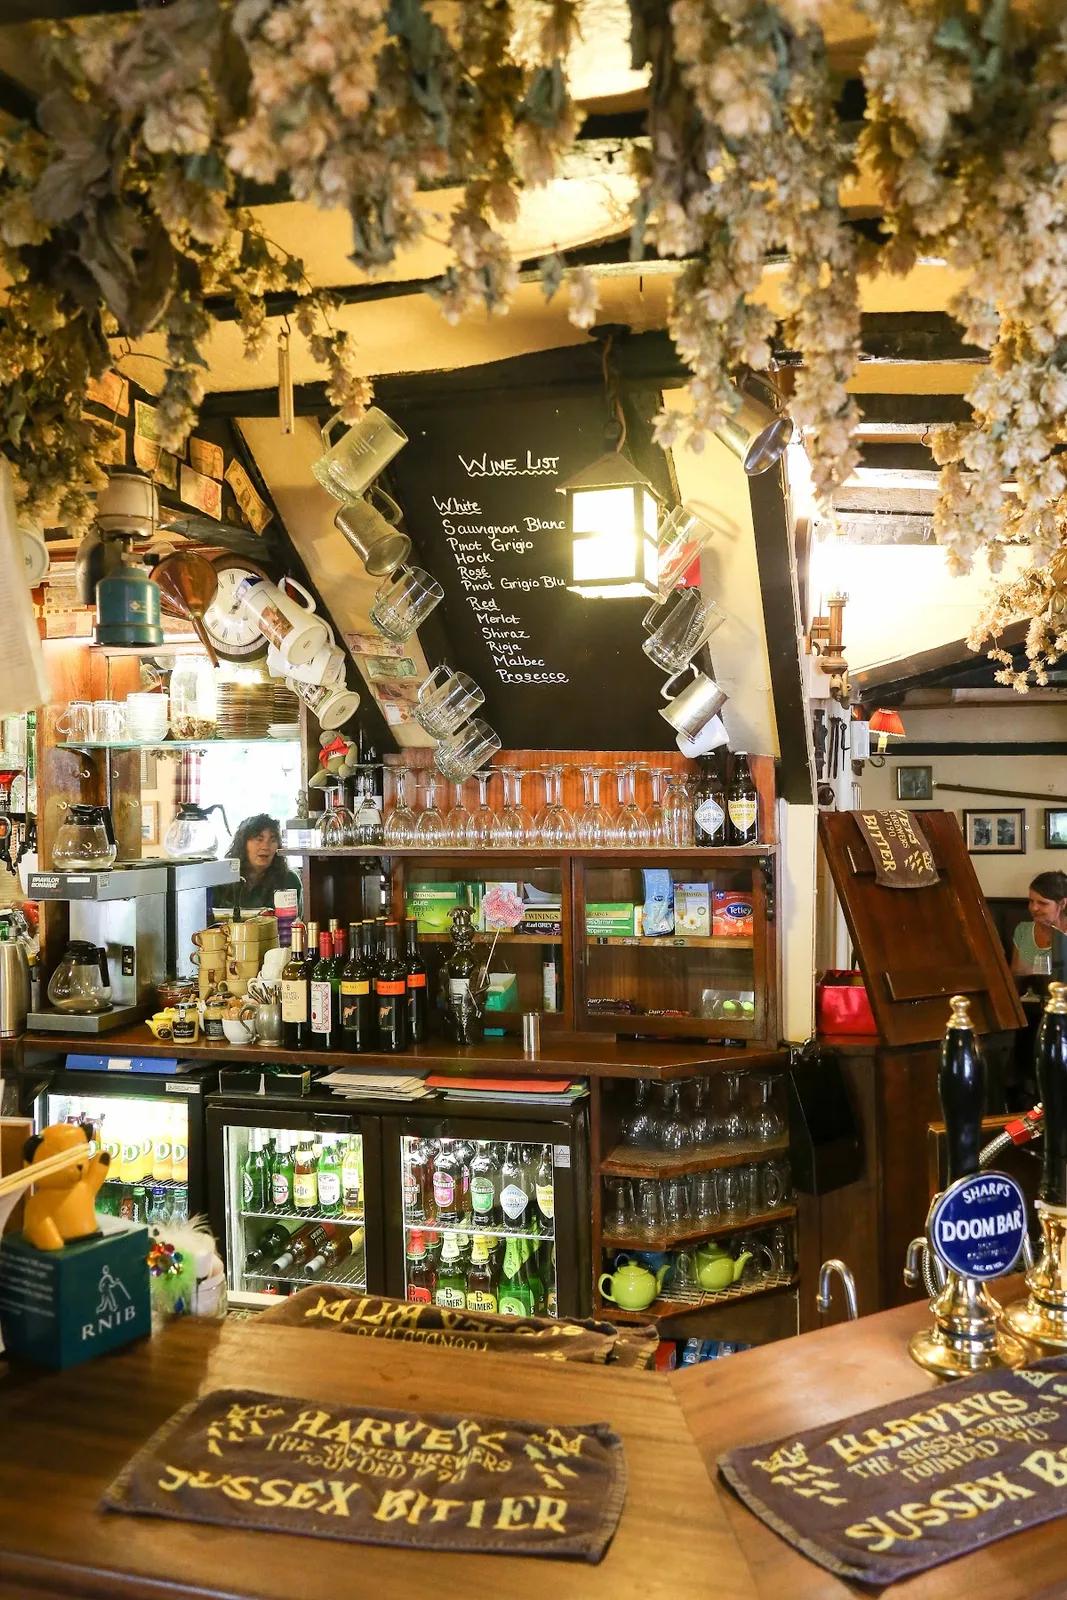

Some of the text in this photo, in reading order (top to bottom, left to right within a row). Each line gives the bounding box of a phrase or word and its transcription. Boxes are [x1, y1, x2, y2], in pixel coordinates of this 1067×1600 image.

[458, 450, 560, 473] WINE LIST
[432, 496, 482, 512] White
[442, 517, 566, 539] Sauvignon Blanc
[446, 537, 534, 553] Pinot Grigio
[454, 553, 495, 565] Hock
[461, 579, 495, 591] Pinot
[500, 578, 540, 593] Grigio
[466, 597, 499, 610] Red
[476, 613, 521, 625] Merlot
[482, 627, 530, 640] Shiraz
[486, 641, 522, 655] Rioja
[493, 655, 545, 667] Malbec
[496, 669, 567, 681] Prosecco
[862, 814, 897, 872] BITTER
[729, 906, 752, 916] Tetley
[962, 1182, 1011, 1204] SHARP'S
[940, 1210, 1021, 1242] DOOM BAR
[82, 1305, 136, 1340] RNIB
[845, 1470, 1037, 1552] SUSSEX
